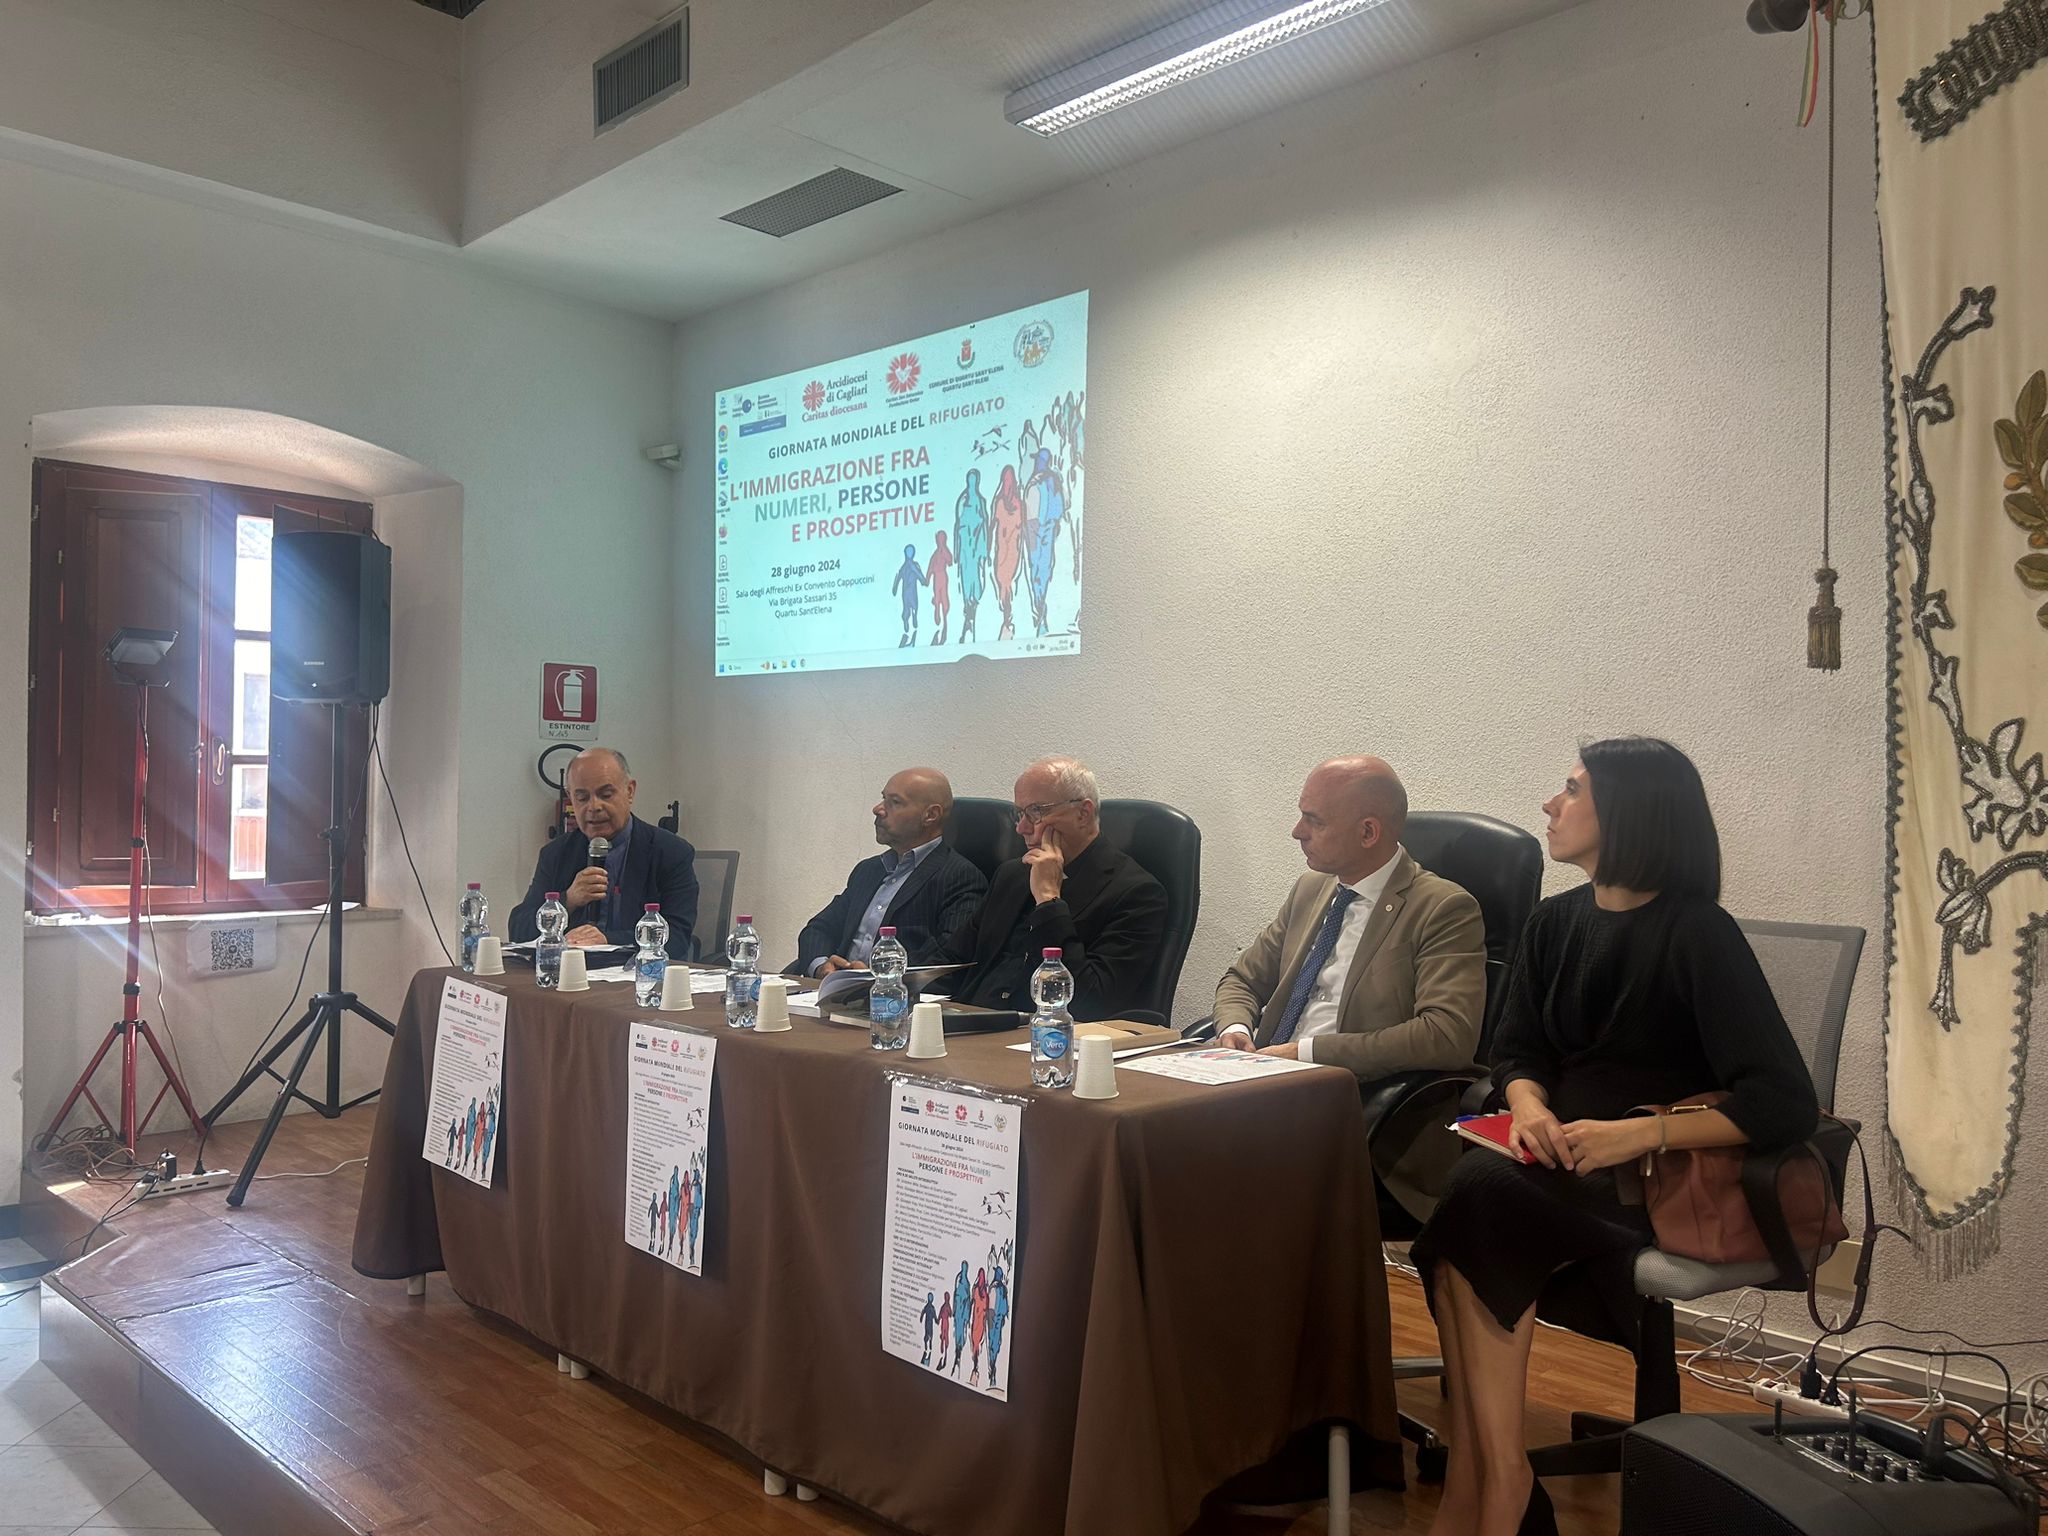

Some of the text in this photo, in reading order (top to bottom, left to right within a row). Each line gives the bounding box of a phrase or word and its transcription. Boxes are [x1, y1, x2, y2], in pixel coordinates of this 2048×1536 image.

[826, 371, 868, 390] Arcidiocesi
[826, 384, 868, 403] di Cagliari
[802, 401, 868, 422] Caritas diocesana
[768, 396, 1005, 460] GIORNATA MONDIALE DEL RIFUGIATO
[730, 445, 930, 501] L'IMMIGRAZIONE FRA
[755, 473, 930, 523] NUMERI, PERSONE
[792, 501, 935, 542] E PROSPETTIVE
[771, 559, 841, 579] 28 giugno 2024
[736, 574, 875, 599] Sala degli Affreschi Ex Convento Cappuccini
[768, 591, 837, 607] Via Brigata Sassari 35
[774, 605, 833, 619] Quartu Sant'Elena
[549, 722, 591, 731] ESTINTORE
[1045, 1040, 1064, 1048] Vera
[898, 1122, 1009, 1153] GIORNATA MONDIALE DEL RIFUGIATO
[918, 1162, 944, 1175] PERSONE
[958, 1160, 968, 1170] FRA
